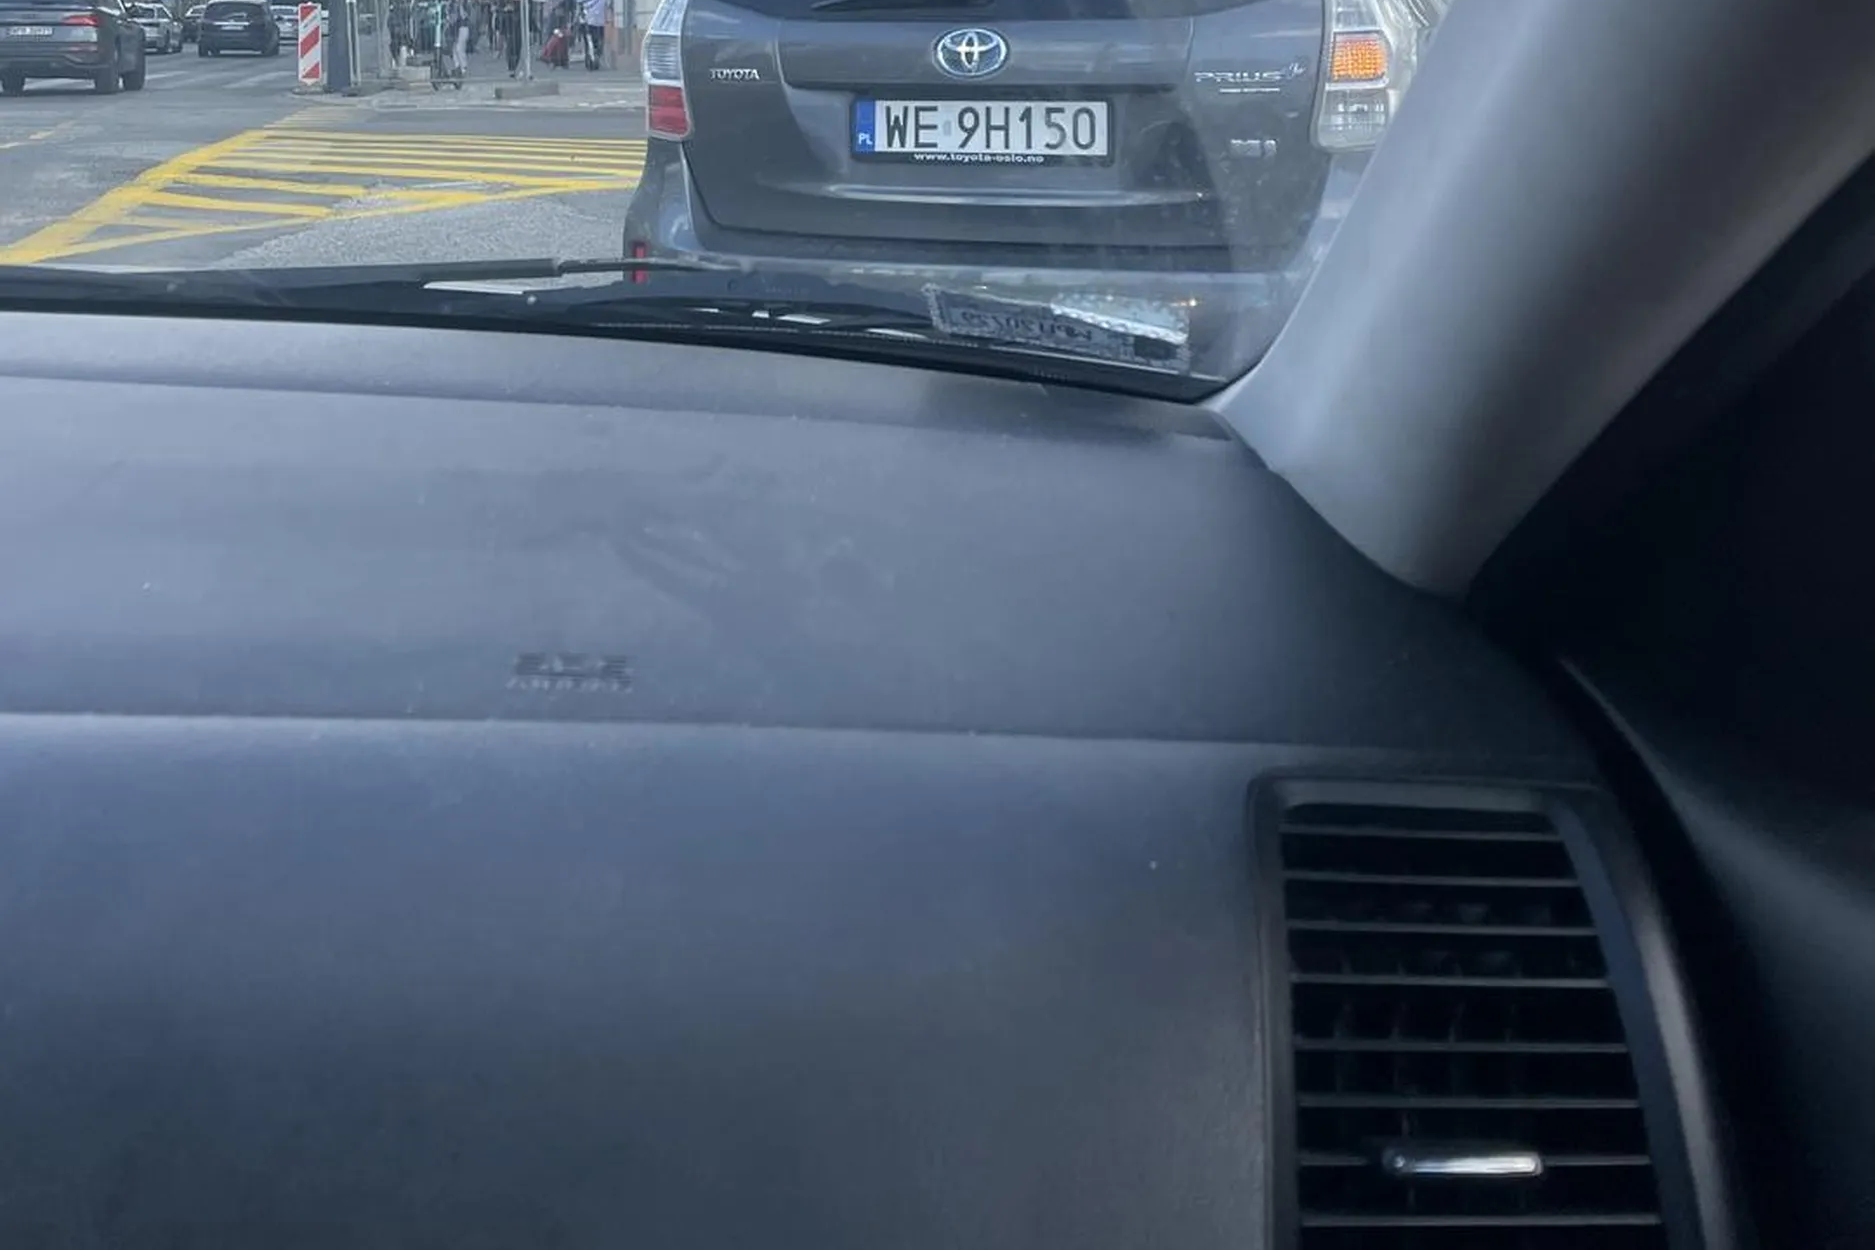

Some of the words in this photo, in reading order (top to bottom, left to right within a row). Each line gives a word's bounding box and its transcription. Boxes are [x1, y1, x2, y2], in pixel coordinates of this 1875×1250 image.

[709, 68, 760, 80] TOYOTA
[885, 105, 939, 149] WE
[957, 106, 1097, 150] 9H150
[858, 132, 873, 145] PL
[914, 152, 1045, 163] www.toyota-oslo.no
